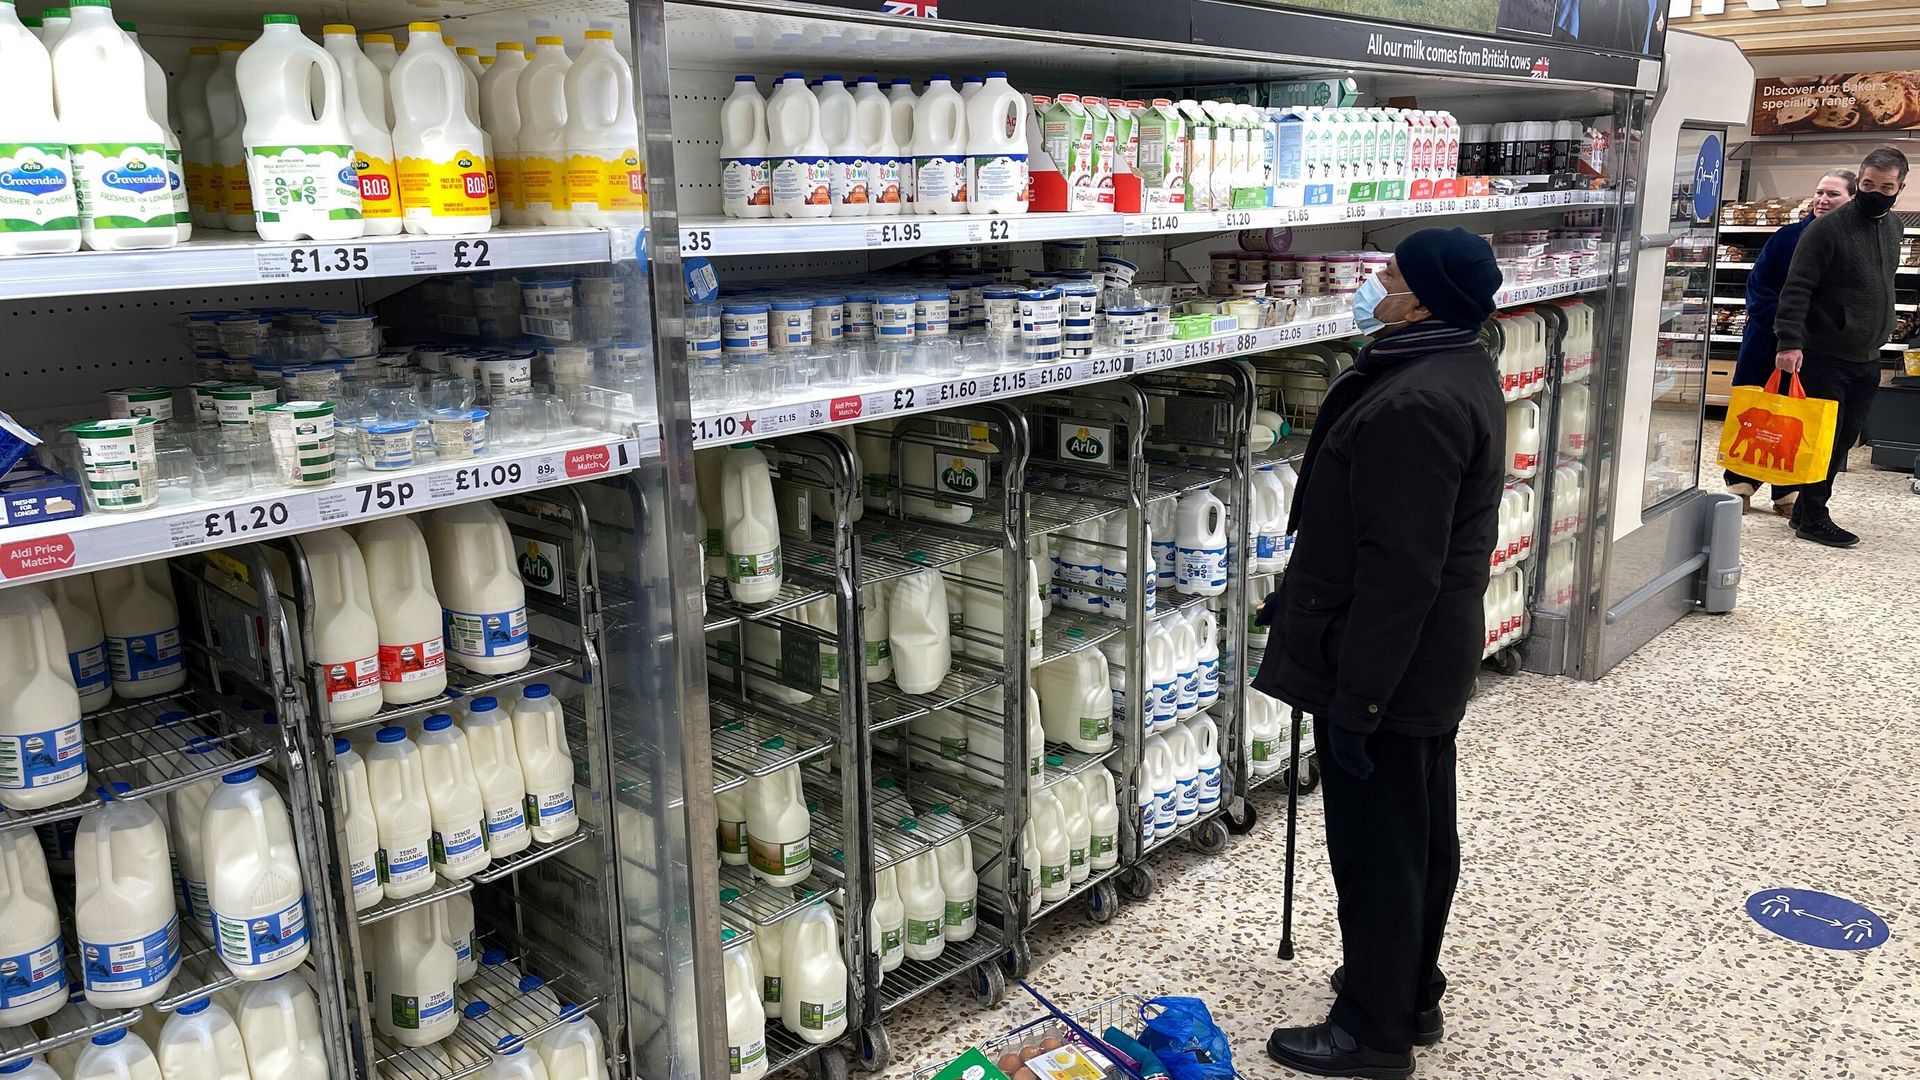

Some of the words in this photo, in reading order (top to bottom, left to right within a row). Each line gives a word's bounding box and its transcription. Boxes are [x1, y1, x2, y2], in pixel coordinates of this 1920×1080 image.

[1367, 33, 1382, 55] All
[1383, 41, 1402, 57] our
[1403, 39, 1424, 60] milk
[1426, 46, 1457, 64] comes
[1458, 45, 1480, 66] from
[1482, 47, 1509, 68] British
[1510, 55, 1531, 70] cows
[1763, 84, 1815, 97] Discover
[1818, 84, 1839, 93] our
[1762, 96, 1819, 110] speciality
[1821, 95, 1856, 108] range
[23, 161, 41, 170] Arla
[128, 161, 144, 170] Arla
[1, 171, 64, 187] Cravendale
[106, 171, 167, 187] Cravendale
[466, 177, 486, 194] B.O.B
[362, 177, 389, 196] B.O.B
[0, 194, 31, 206] RESHER
[100, 193, 136, 205] FRESHER
[1439, 200, 1456, 211] £1.80
[1464, 199, 1480, 209] £1.80
[1487, 198, 1500, 208] £1.8
[1514, 196, 1529, 206] £1.10
[1346, 205, 1366, 218] £1.65
[1415, 202, 1433, 213] £1.65
[1226, 213, 1250, 226] £1.20
[1287, 209, 1309, 222] £1.65
[990, 219, 1009, 240] £2
[1152, 216, 1178, 230] £1.40
[882, 223, 921, 242] £1.95
[682, 231, 712, 251] .35
[290, 247, 369, 273] £1.35
[454, 240, 491, 268] £2
[1514, 289, 1529, 301] £1.10
[1535, 286, 1547, 298] 75p
[1552, 283, 1565, 295] £1.15
[1279, 327, 1302, 341] £2.05
[1316, 321, 1337, 336] £1.10
[1237, 334, 1257, 351] 88p
[1146, 347, 1173, 365] £1.30
[1184, 341, 1209, 359] £1.15
[1092, 358, 1122, 376] £2.10
[1041, 366, 1072, 385] £1.60
[993, 372, 1026, 393] £1.15
[940, 380, 977, 401] £1.60
[844, 400, 858, 408] Price
[893, 388, 915, 410] £2
[778, 413, 797, 423] £1.15
[810, 409, 822, 418] 89p
[838, 408, 854, 416] Match
[691, 416, 736, 441] £1.10
[1071, 438, 1097, 454] Arla
[571, 454, 584, 462] Aldi
[586, 453, 603, 461] Price
[537, 464, 555, 475] 89p
[577, 461, 599, 470] Match
[456, 463, 521, 491] £1.09
[947, 470, 973, 487] Arla
[12, 498, 38, 507] FRESHER
[355, 481, 414, 513] 75p
[205, 502, 288, 537] £1.20
[10, 547, 32, 559] Aldi
[34, 544, 64, 555] Price
[21, 555, 57, 569] Match
[523, 557, 548, 579] Arla
[544, 795, 569, 808] ORGANIC
[548, 792, 566, 801] TESCO
[491, 811, 519, 823] ORGANIC
[496, 807, 513, 817] TESCO
[449, 833, 477, 846] ORGANIC
[453, 829, 471, 839] TESCO
[393, 852, 424, 864] ORGANIC
[399, 847, 418, 857] TESCO
[350, 861, 365, 870] ESCO
[351, 865, 371, 876] GANIC
[425, 994, 450, 1008] ORGANIC
[430, 991, 446, 1001] TESCO
